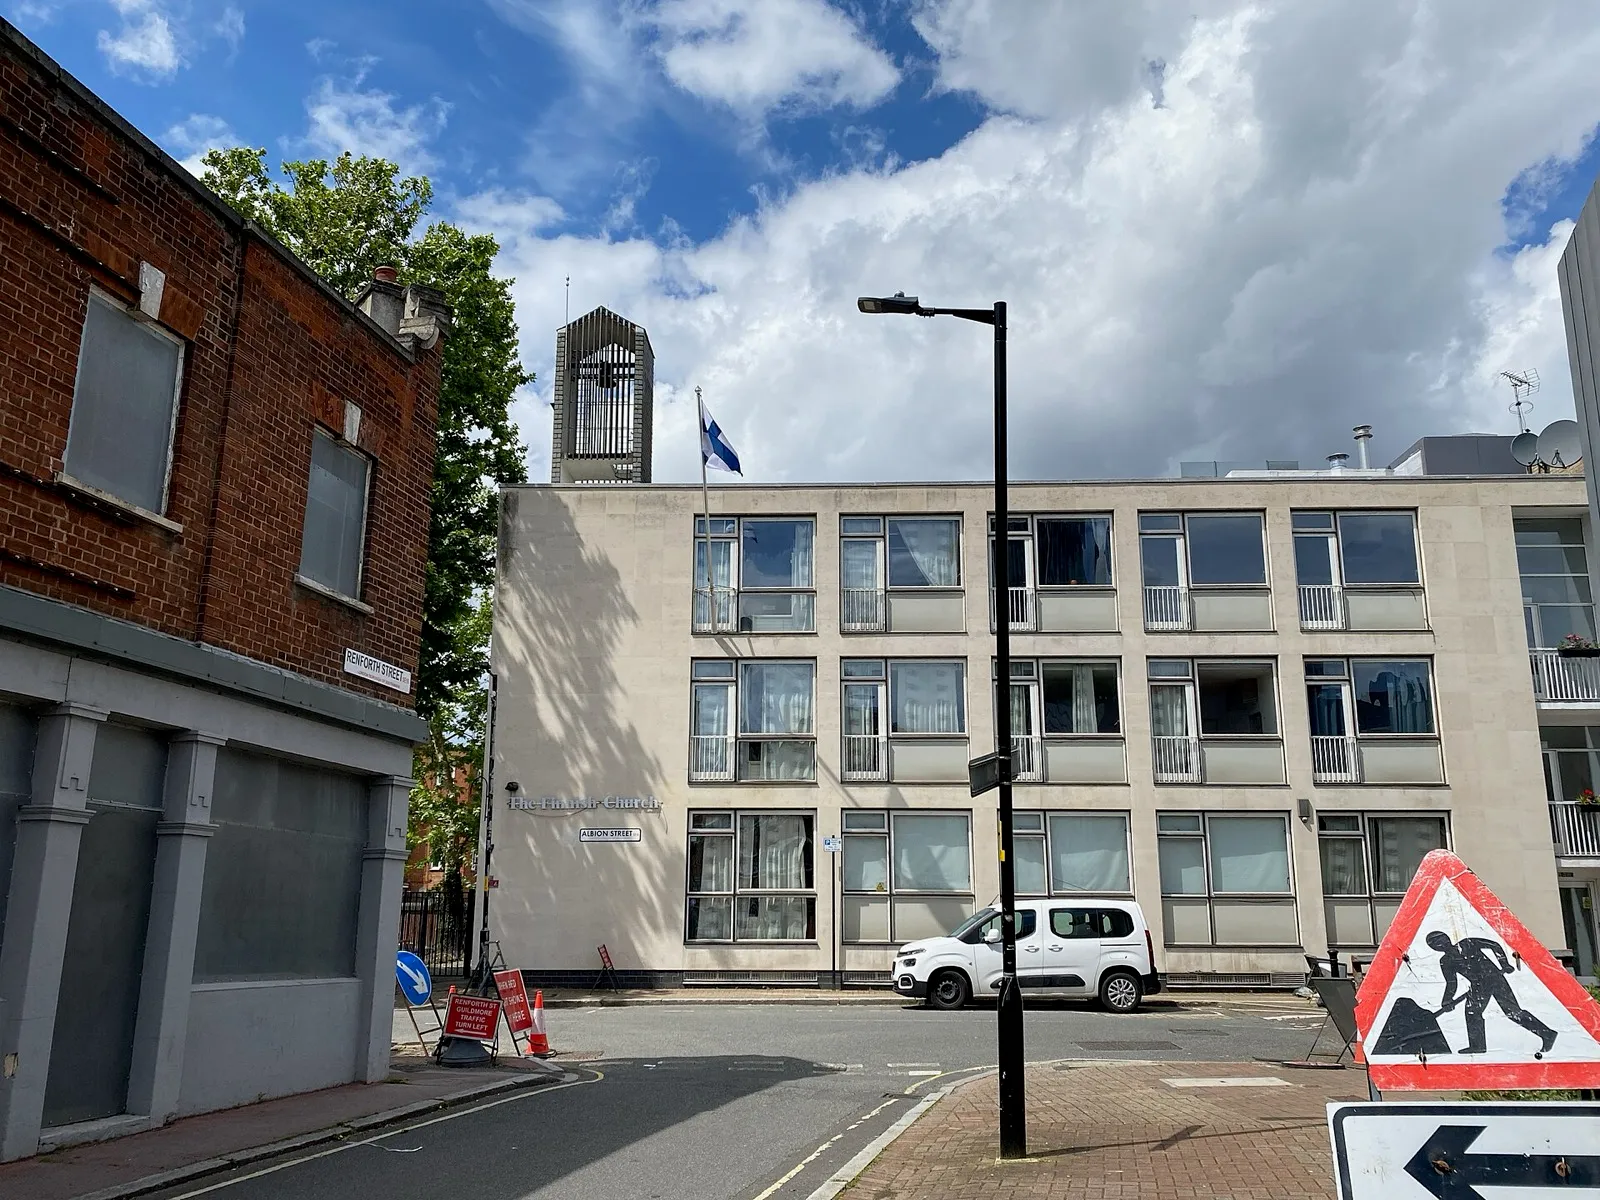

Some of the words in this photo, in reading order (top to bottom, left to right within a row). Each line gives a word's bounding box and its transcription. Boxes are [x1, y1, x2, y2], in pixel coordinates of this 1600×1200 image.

[346, 650, 380, 673] RENFORTH
[381, 664, 403, 682] STREET
[509, 796, 536, 809] The
[603, 795, 659, 809] Church
[455, 998, 488, 1008] RENFORTH
[456, 1006, 493, 1017] GUILDMORE
[460, 1014, 486, 1023] TRAFFIC
[455, 1021, 472, 1029] TURN
[472, 1023, 489, 1031] LEFT
